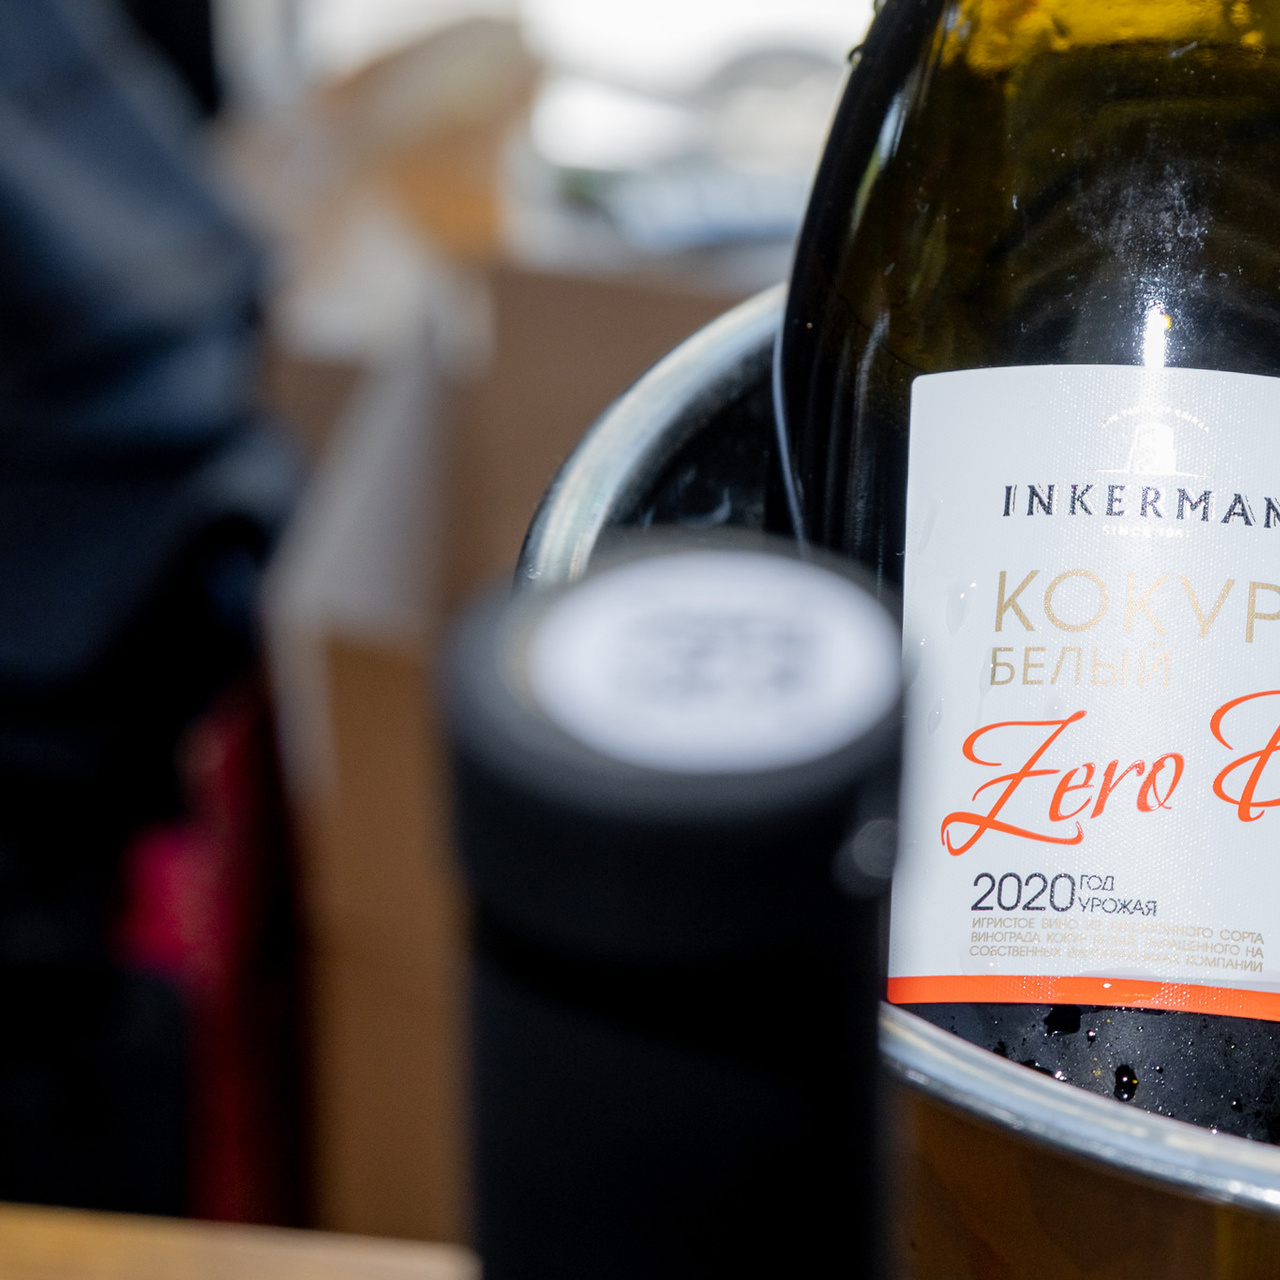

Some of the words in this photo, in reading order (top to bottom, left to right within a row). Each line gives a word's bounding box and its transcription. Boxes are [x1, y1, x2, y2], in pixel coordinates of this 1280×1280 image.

[990, 643, 1172, 690] БЕЛЫЙ
[940, 710, 1185, 857] Zero
[970, 872, 1076, 912] 2020
[1079, 874, 1115, 892] ГОД
[1077, 897, 1158, 917] УРОЖАЯ
[971, 931, 1041, 944] ВИНОГРАДА
[1246, 946, 1265, 959] НА
[972, 917, 1035, 929] ИГРИСТОЕ
[1041, 918, 1079, 930] ВИНО
[1219, 929, 1265, 945] СОРТА
[1186, 954, 1264, 972] КОМПАНИИ
